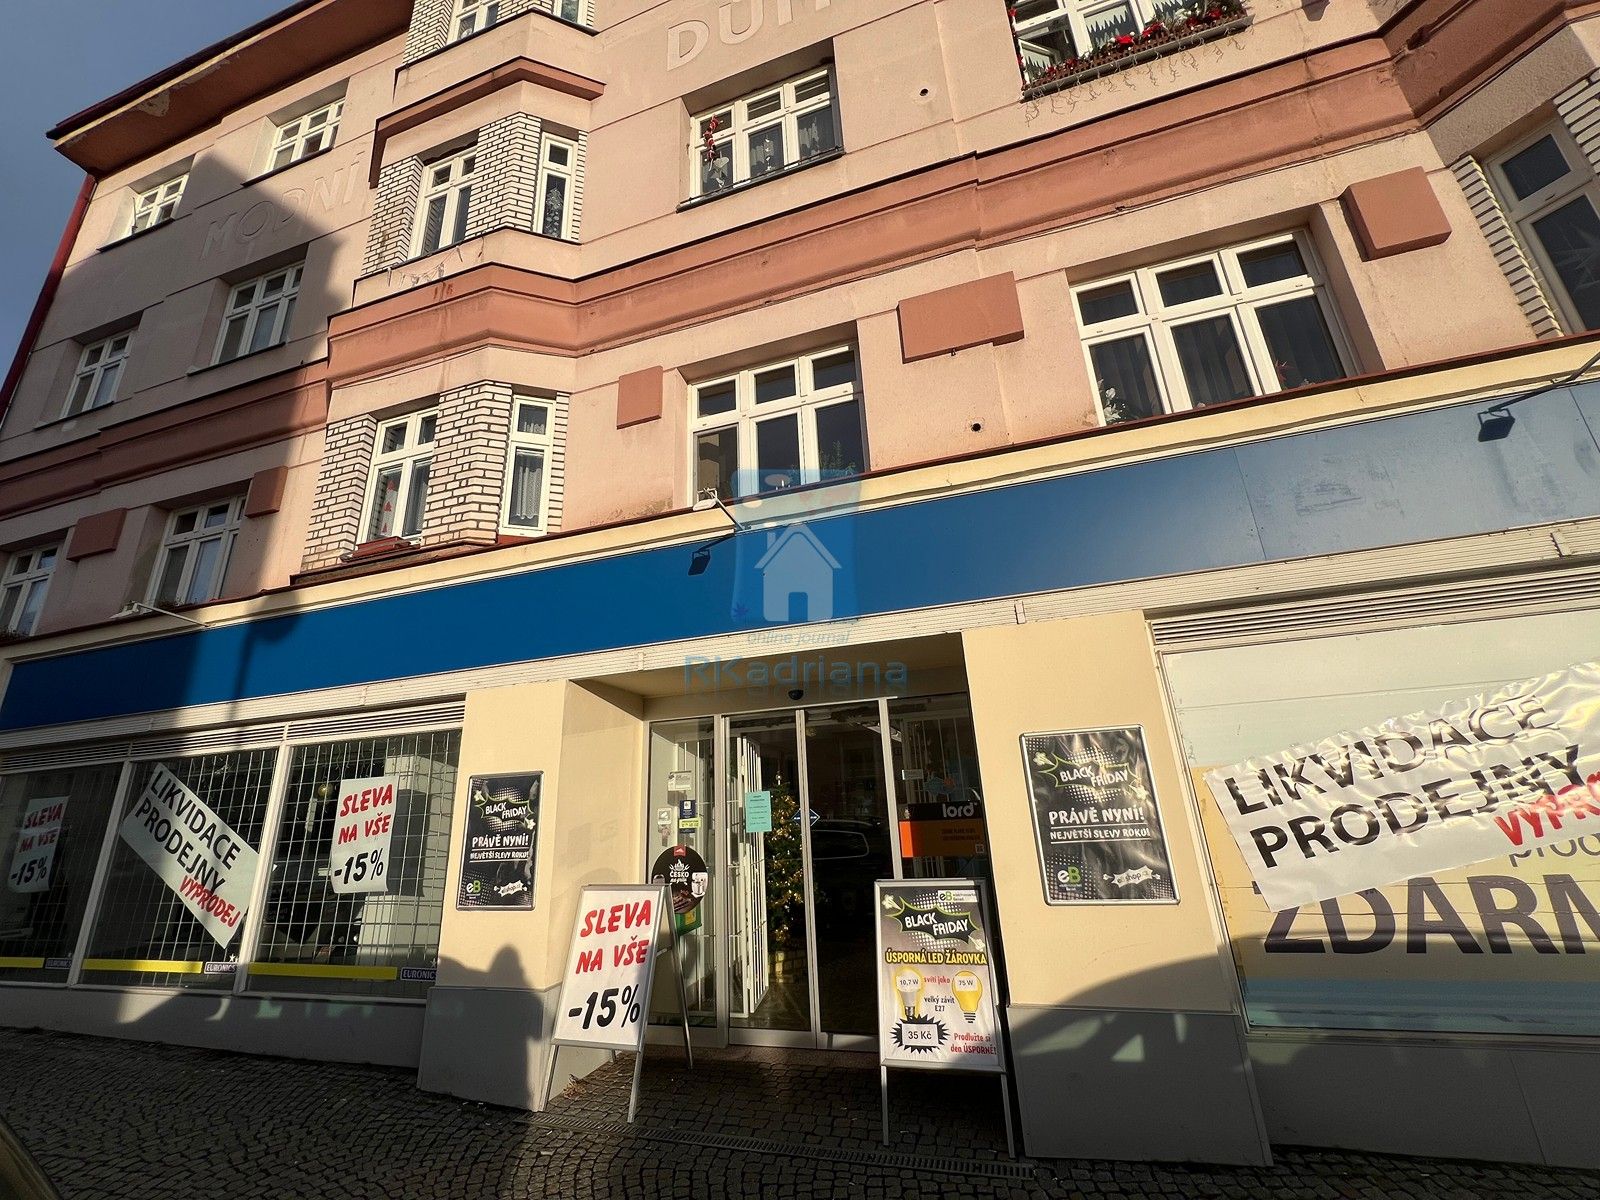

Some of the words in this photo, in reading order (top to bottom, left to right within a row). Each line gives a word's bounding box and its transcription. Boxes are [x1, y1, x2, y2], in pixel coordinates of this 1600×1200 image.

[1224, 694, 1561, 816] LIKVIDACE
[1060, 766, 1093, 782] BLACK
[1091, 769, 1129, 787] FRIDAY
[340, 783, 393, 818] SLEVA
[485, 802, 507, 814] BLACK
[942, 802, 974, 818] lord
[1250, 744, 1585, 868] PRODEJNY
[24, 803, 64, 830] SLEVA
[150, 770, 241, 870] LIKVIDACE
[501, 806, 527, 820] FRIDAY
[1049, 808, 1100, 825] PRÁVĚ
[1102, 806, 1145, 823] NYNÍ!
[338, 824, 358, 845] NA
[364, 812, 392, 838] VŠE
[1050, 828, 1092, 840] NEJVĚTŠÍ
[1094, 828, 1121, 839] SLEVY
[135, 797, 226, 893] PRODEJNY
[472, 834, 501, 848] PRÁVĚ
[502, 833, 529, 847] NYNÍ!
[495, 850, 511, 859] SLEVY
[11, 856, 48, 885] -15%
[334, 848, 384, 884] -15%
[179, 875, 241, 928] VYPRODEJ
[580, 900, 651, 938] SLEVA
[904, 912, 937, 928] BLACK
[932, 919, 969, 935] FRIDAY
[575, 948, 603, 974] NA
[613, 935, 650, 968] VŠE
[886, 948, 927, 964] ÚSPORNÁ
[927, 952, 944, 964] LED
[945, 949, 987, 965] ŽÁROVKA
[568, 984, 640, 1030] -15%
[908, 1031, 919, 1040] 35
[921, 1029, 932, 1040] Kč
[951, 1044, 962, 1053] den
